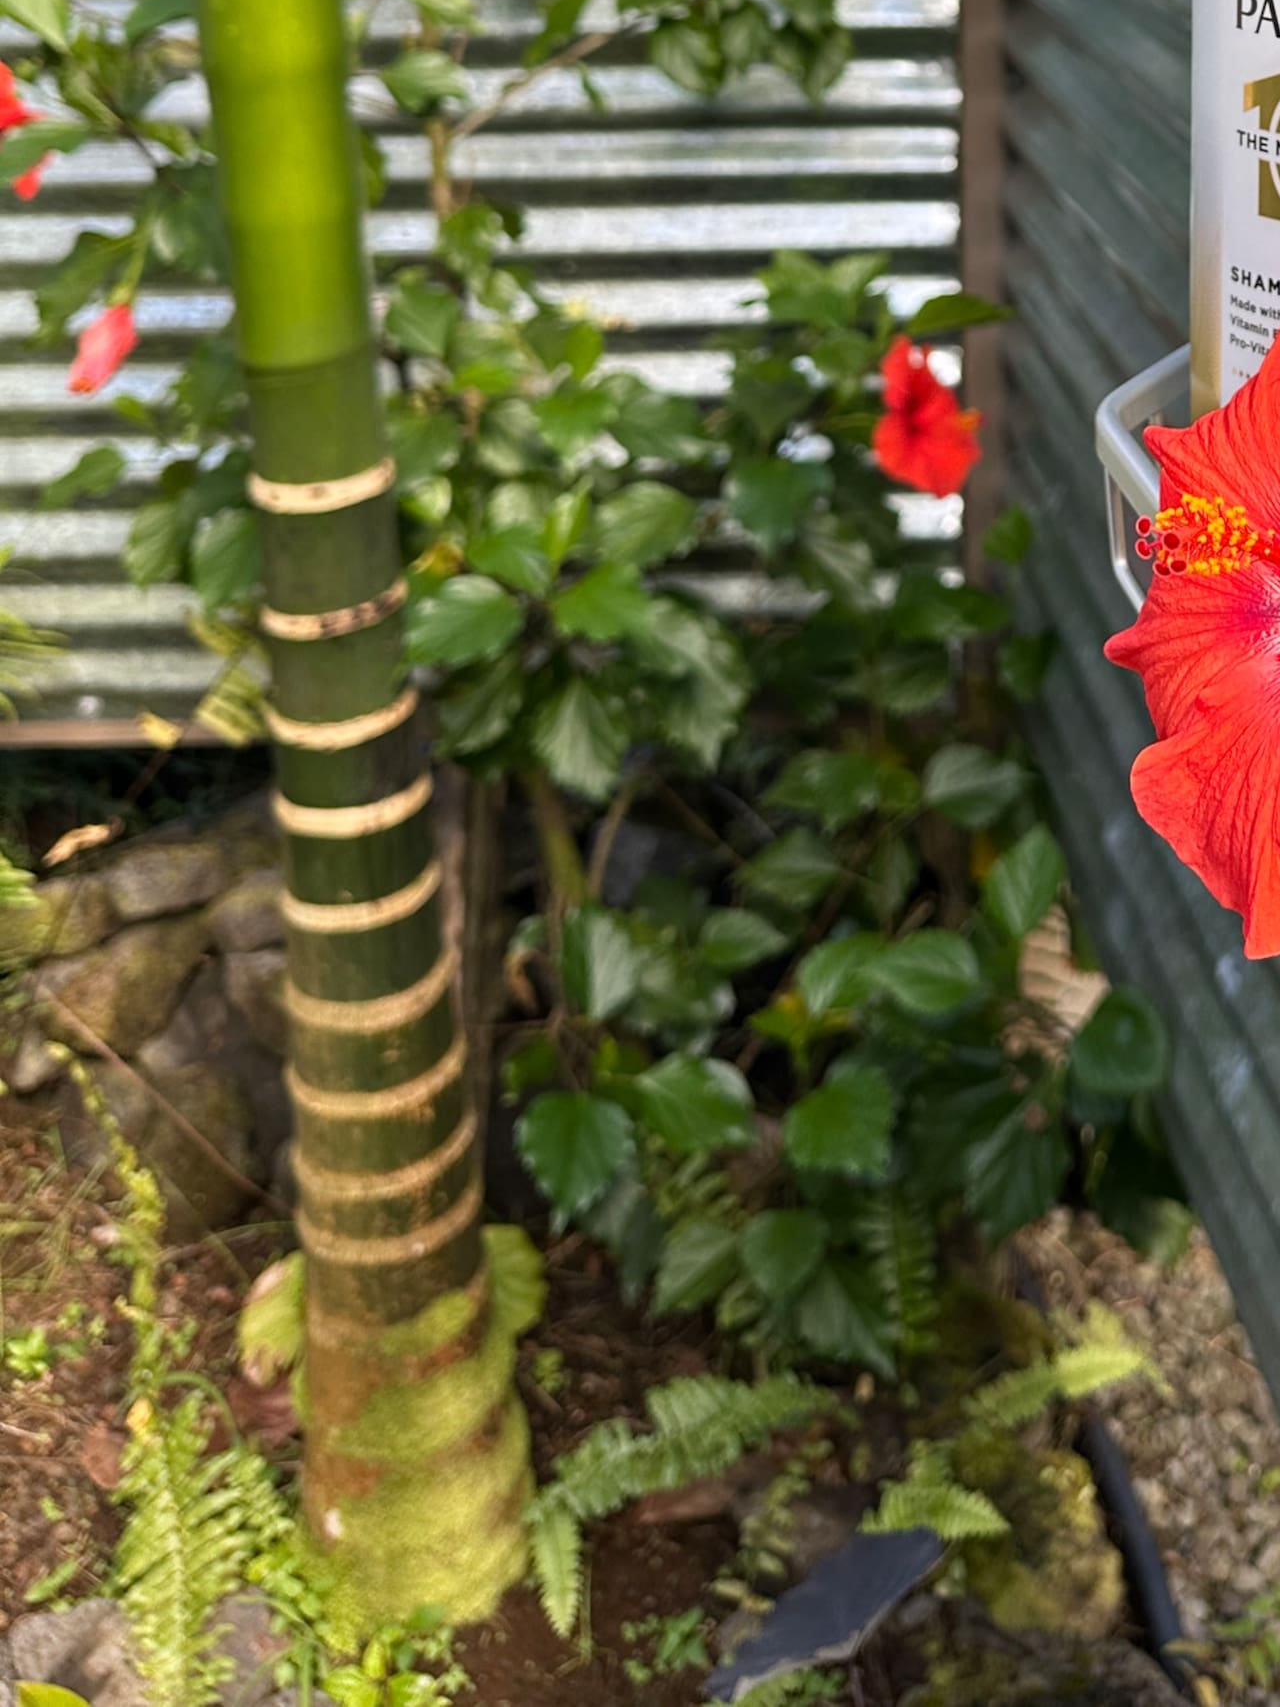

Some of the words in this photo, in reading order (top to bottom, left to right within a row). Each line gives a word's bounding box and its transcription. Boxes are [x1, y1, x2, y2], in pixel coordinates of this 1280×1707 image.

[1237, 130, 1269, 153] THE
[1230, 294, 1256, 313] Made
[1230, 314, 1269, 336] Vitamin
[1229, 333, 1269, 356] Pro-Vit
